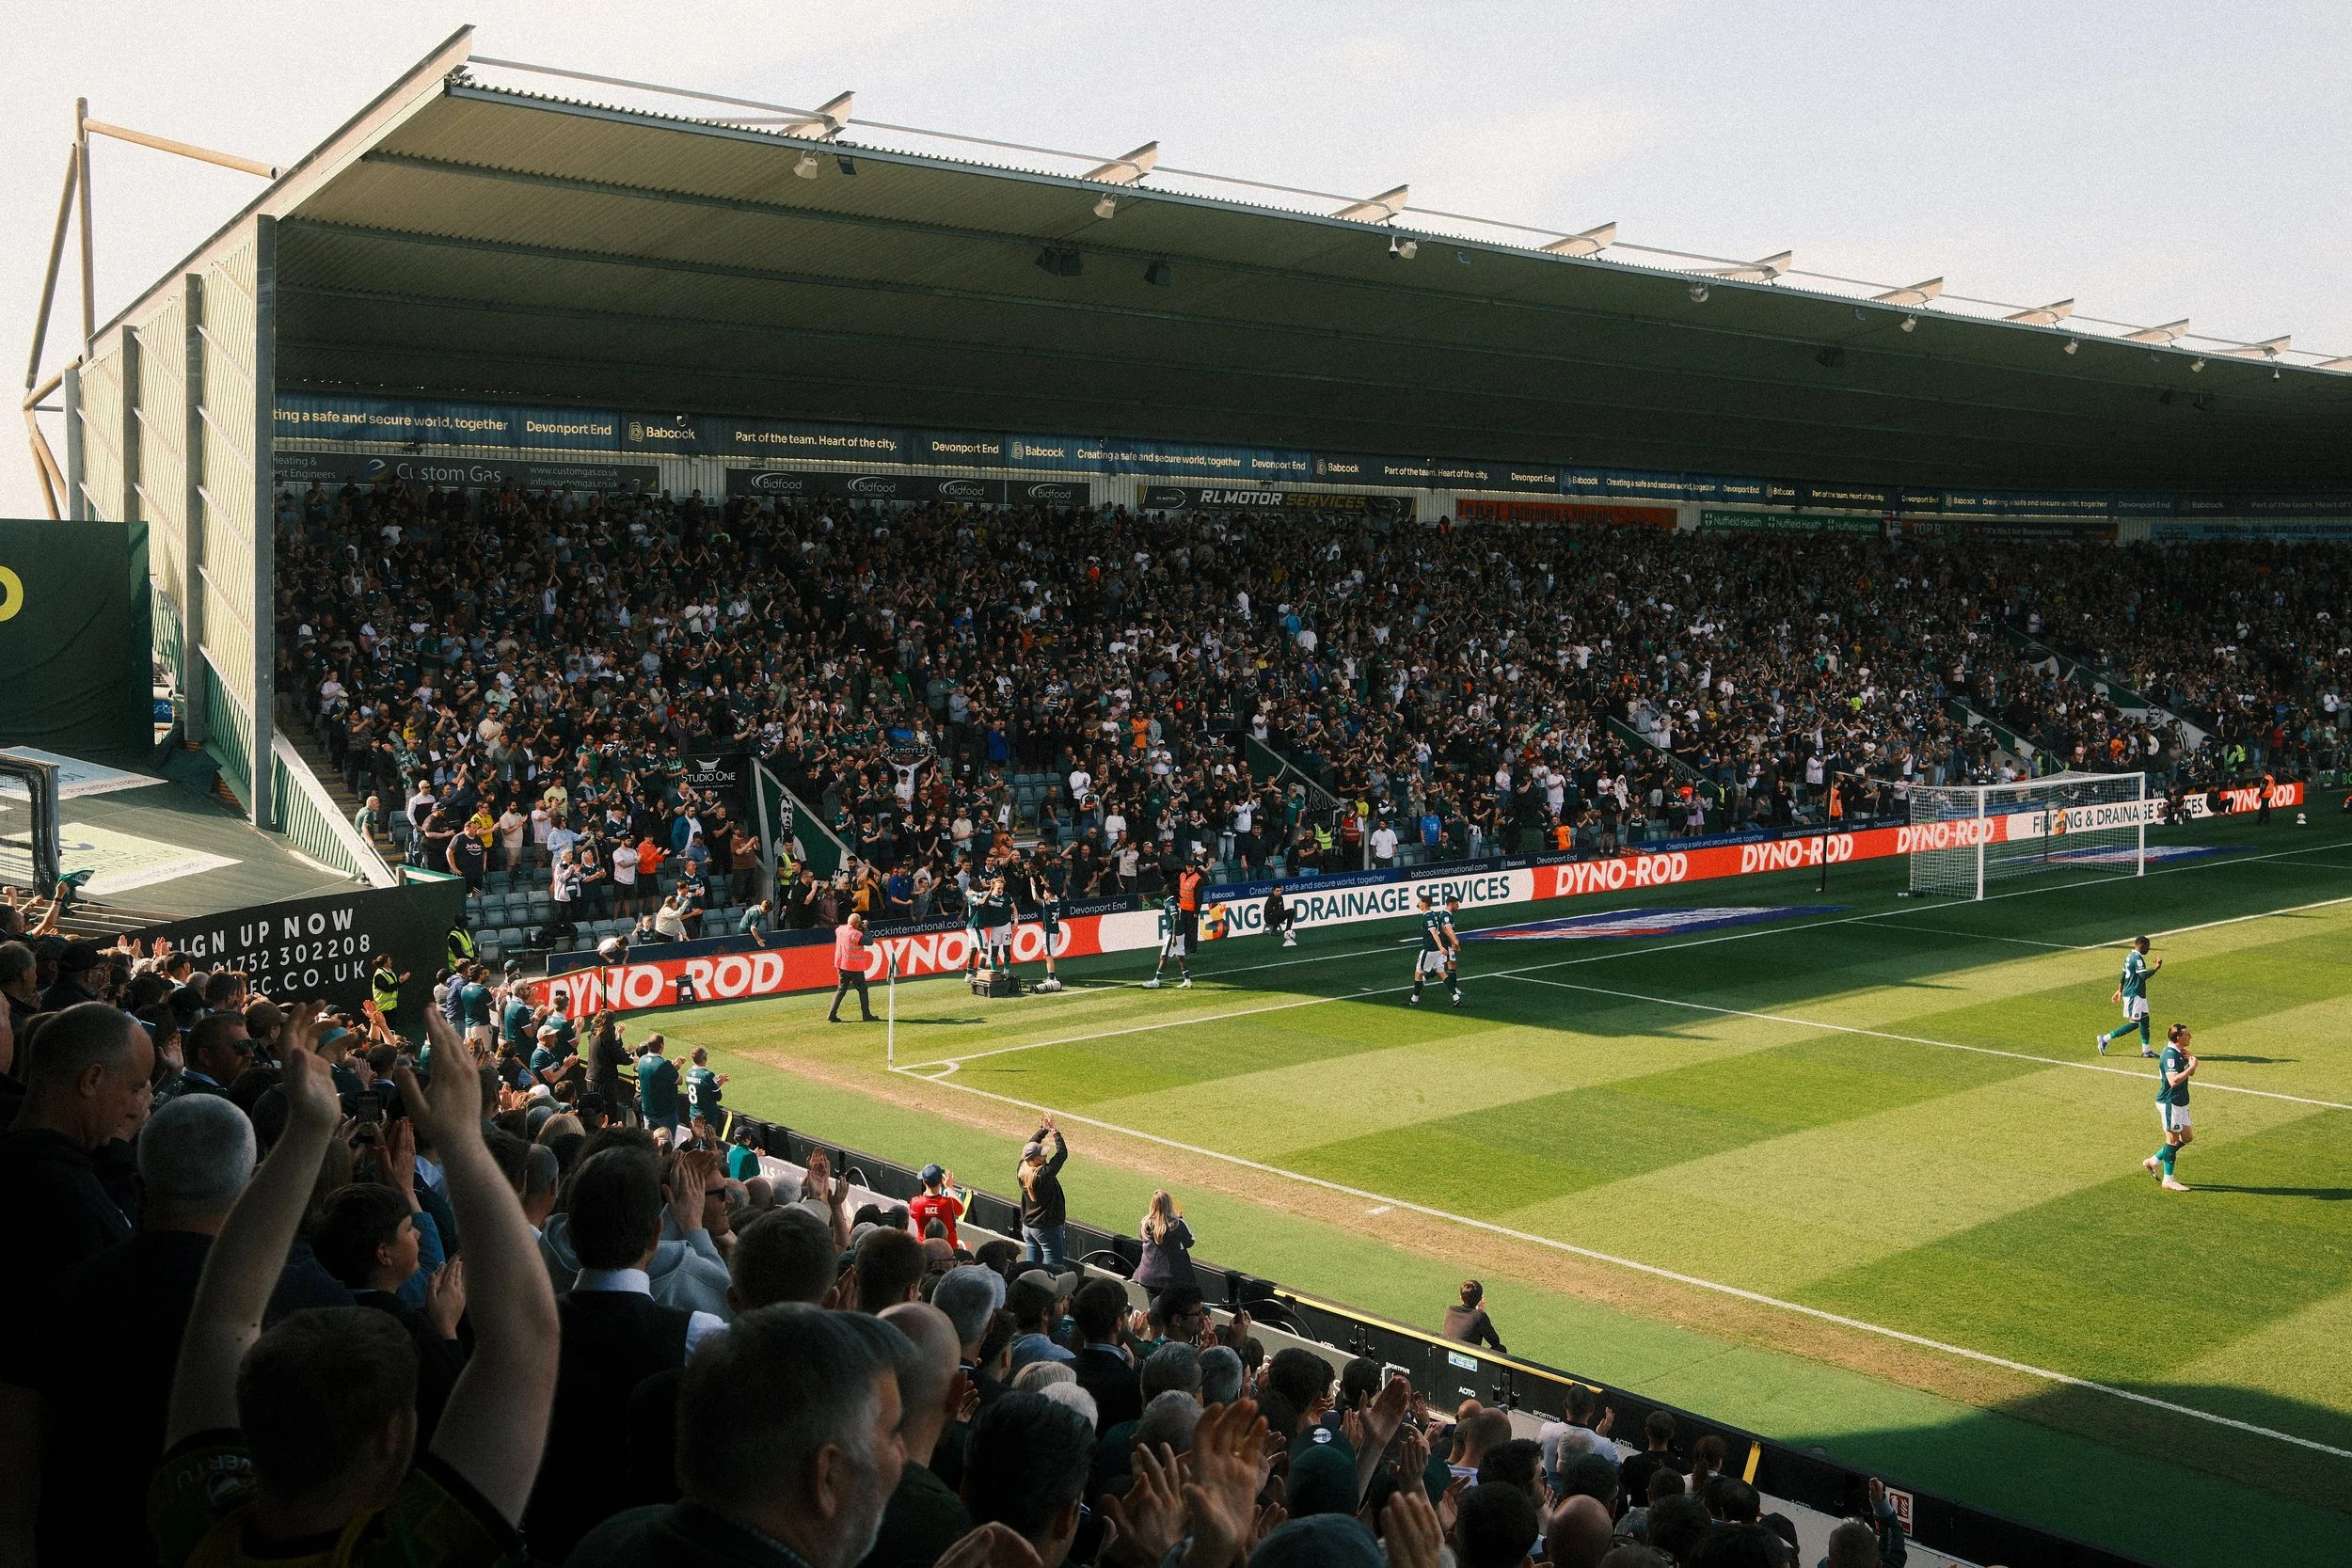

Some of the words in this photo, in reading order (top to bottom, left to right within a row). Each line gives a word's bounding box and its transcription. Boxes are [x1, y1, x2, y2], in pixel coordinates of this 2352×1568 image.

[303, 413, 309, 421] a
[312, 411, 340, 422] safe
[342, 413, 367, 424] and
[369, 416, 412, 426] secure
[414, 417, 453, 429] world,
[455, 418, 508, 432] together
[527, 421, 589, 435] Devonport
[591, 424, 612, 436] End
[647, 427, 696, 440] Babcock
[736, 431, 756, 442] Part
[758, 433, 770, 442] of
[770, 433, 788, 444] the
[788, 435, 817, 445] team.
[818, 436, 846, 446] Heart
[848, 436, 858, 447] of
[859, 438, 875, 448] the
[877, 438, 897, 451] city.
[932, 441, 980, 453] Devonport
[982, 444, 999, 453] End
[1025, 446, 1065, 457] Babcock
[310, 457, 317, 466] &
[1078, 450, 1114, 461] Creating
[1120, 452, 1137, 461] safe
[1183, 455, 1206, 467] world,
[1208, 457, 1241, 467] together
[1251, 458, 1291, 469] Devonport
[1293, 461, 1306, 470] End
[290, 468, 336, 480] Engineers
[469, 466, 501, 482] Gas
[530, 467, 618, 478] www.customgas.co.uk
[1328, 463, 1359, 473] Babcock
[1385, 467, 1398, 475] Part
[1400, 467, 1407, 476] of
[1407, 467, 1419, 476] the
[1419, 468, 1437, 477] team.
[1438, 468, 1455, 478] Heart
[1475, 470, 1488, 481] city.
[1511, 472, 1543, 483] Devonport
[1543, 474, 1555, 483] End
[1573, 476, 1597, 485] Babcock
[763, 478, 803, 490] Bidfood
[859, 482, 896, 493] Bidfood
[1607, 478, 1630, 488] Creating
[1635, 480, 1646, 488] safe
[1647, 481, 1658, 489] and
[1693, 483, 1716, 493] together
[1724, 484, 1750, 495] Devonport
[1750, 485, 1759, 494] End
[949, 485, 984, 496] Bidfood
[1039, 489, 1071, 499] Bidfood
[1773, 487, 1795, 497] Babcock
[1285, 494, 1366, 508] SERVICES
[1902, 495, 1929, 504] Devonport
[1953, 497, 1976, 505] Babcock
[2119, 500, 2156, 510] Devonport
[2156, 500, 2170, 509] End
[2192, 500, 2223, 509] Babcock
[1713, 516, 1739, 527] Nuffield
[1740, 517, 1762, 527] Health
[1776, 518, 1801, 528] Nuffield
[1803, 519, 1821, 530] Health
[1836, 521, 1859, 531] Nuffield
[1860, 522, 1878, 532] Health
[682, 771, 715, 783] STUDIO
[715, 770, 736, 781] ONE
[2086, 812, 2093, 826] &
[1897, 816, 1994, 853] DYNO-ROD
[1666, 842, 1687, 851] Creating
[1743, 834, 1765, 843] together
[1536, 854, 1565, 865] Devonport
[1567, 853, 1578, 863] End
[1742, 834, 1853, 873] DYNO-ROD
[1507, 859, 1526, 867] Babcock
[1411, 863, 1488, 879] babcockinternational.com
[1555, 852, 1688, 896] DYNO-ROD
[1285, 883, 1299, 893] safe
[1313, 880, 1336, 889] secure
[1337, 878, 1356, 887] world,
[1358, 875, 1385, 884] together
[1212, 891, 1235, 899] Babcock
[1294, 887, 1409, 923] DRAINAGE
[1416, 876, 1510, 907] SERVICES
[1070, 903, 1111, 915] Devonport
[1112, 901, 1127, 911] End
[1010, 912, 1039, 922] Bbcock
[241, 921, 269, 948] UP
[284, 909, 354, 941] NOW
[213, 952, 269, 973] 01752
[279, 933, 370, 967] 302208
[548, 952, 784, 1016] DYNO-ROD
[688, 1084, 698, 1104] 8
[925, 1206, 938, 1215] RICE
[1386, 1362, 1409, 1374] SPORTFIVE
[1458, 1386, 1475, 1398] AOTO
[1533, 1410, 1560, 1422] SPORTFIVE
